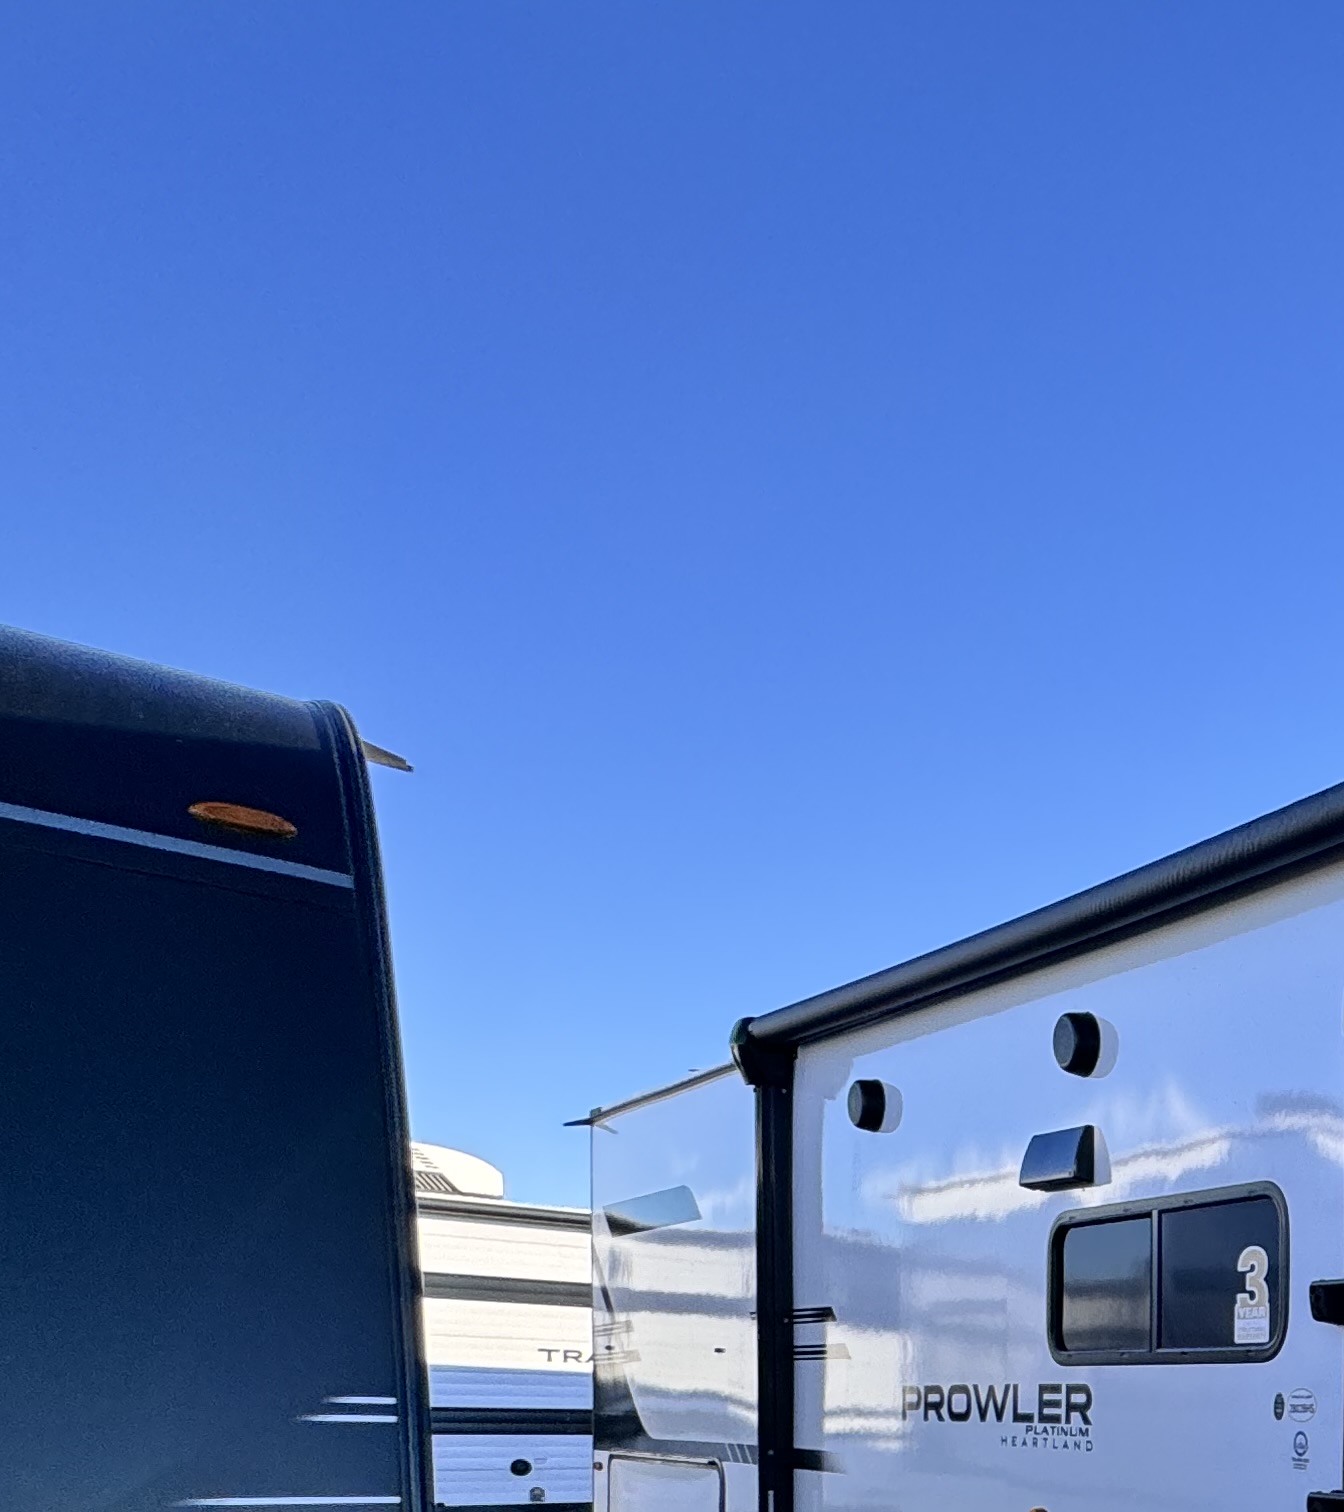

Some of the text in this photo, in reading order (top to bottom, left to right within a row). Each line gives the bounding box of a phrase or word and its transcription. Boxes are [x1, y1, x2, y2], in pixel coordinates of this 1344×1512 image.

[1237, 1246, 1269, 1306] 3
[902, 1384, 1093, 1425] PROWLER
[1001, 1436, 1093, 1452] HEARTLAND
[1025, 1425, 1090, 1438] PLATINUM
